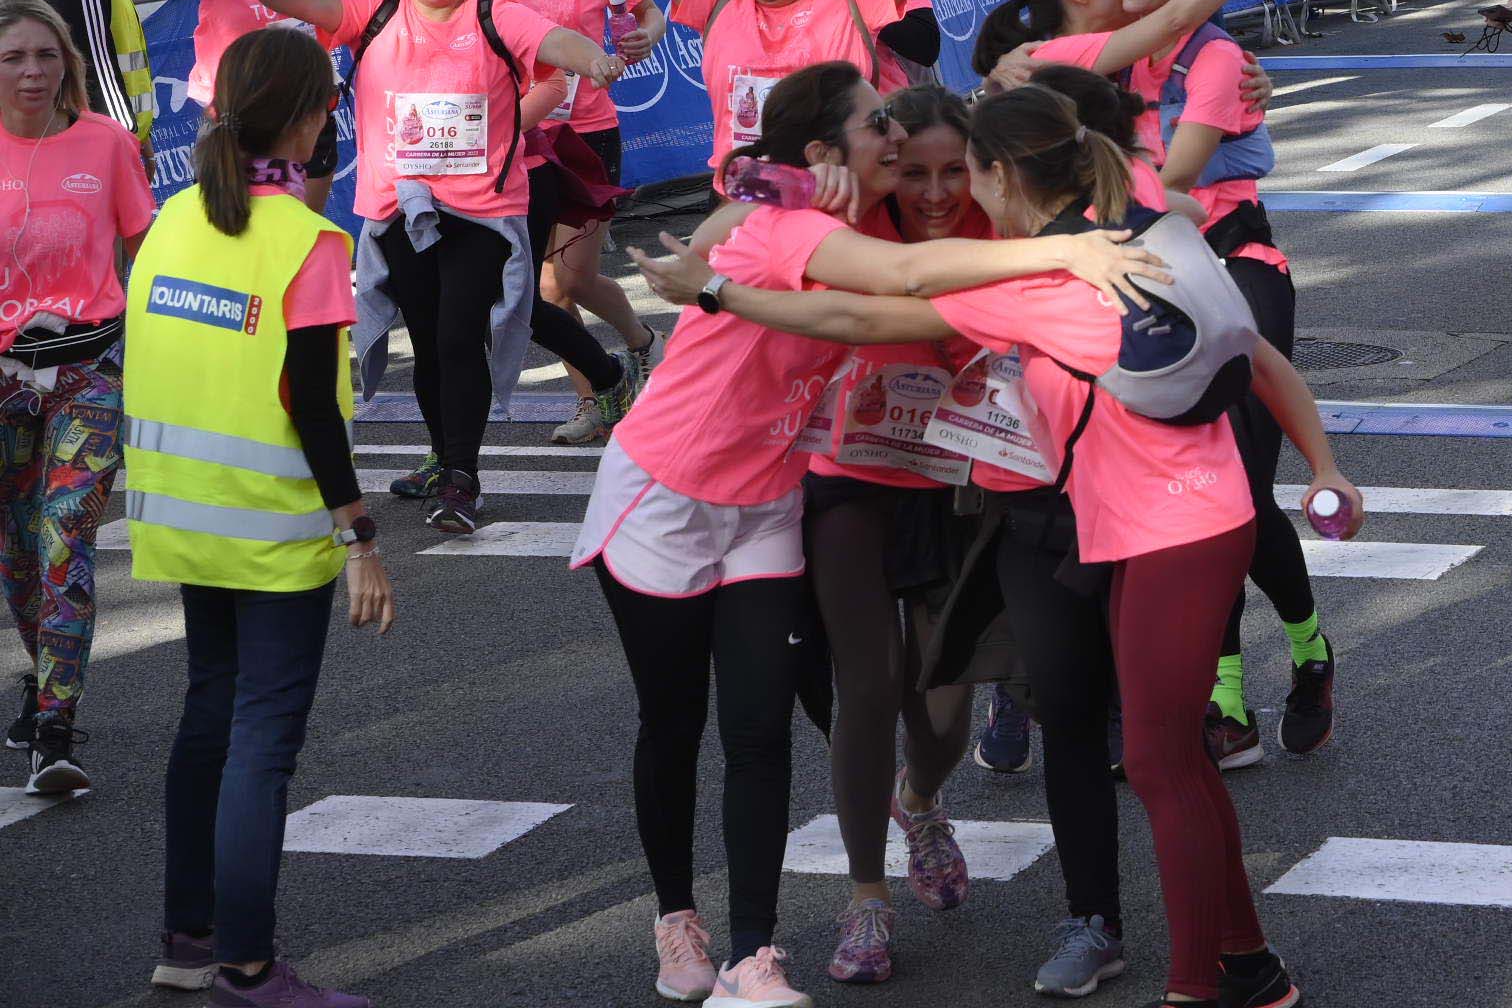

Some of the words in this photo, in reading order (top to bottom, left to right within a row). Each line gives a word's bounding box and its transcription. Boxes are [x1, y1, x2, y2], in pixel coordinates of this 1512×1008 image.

[250, 4, 276, 21] TU
[426, 126, 458, 138] 016
[429, 141, 454, 149] 26188
[889, 406, 932, 426] 016
[986, 410, 1020, 430] 11736
[891, 426, 924, 440] 11734
[939, 428, 978, 449] OYSHO
[849, 447, 888, 458] OYSHO
[919, 460, 959, 474] Santander
